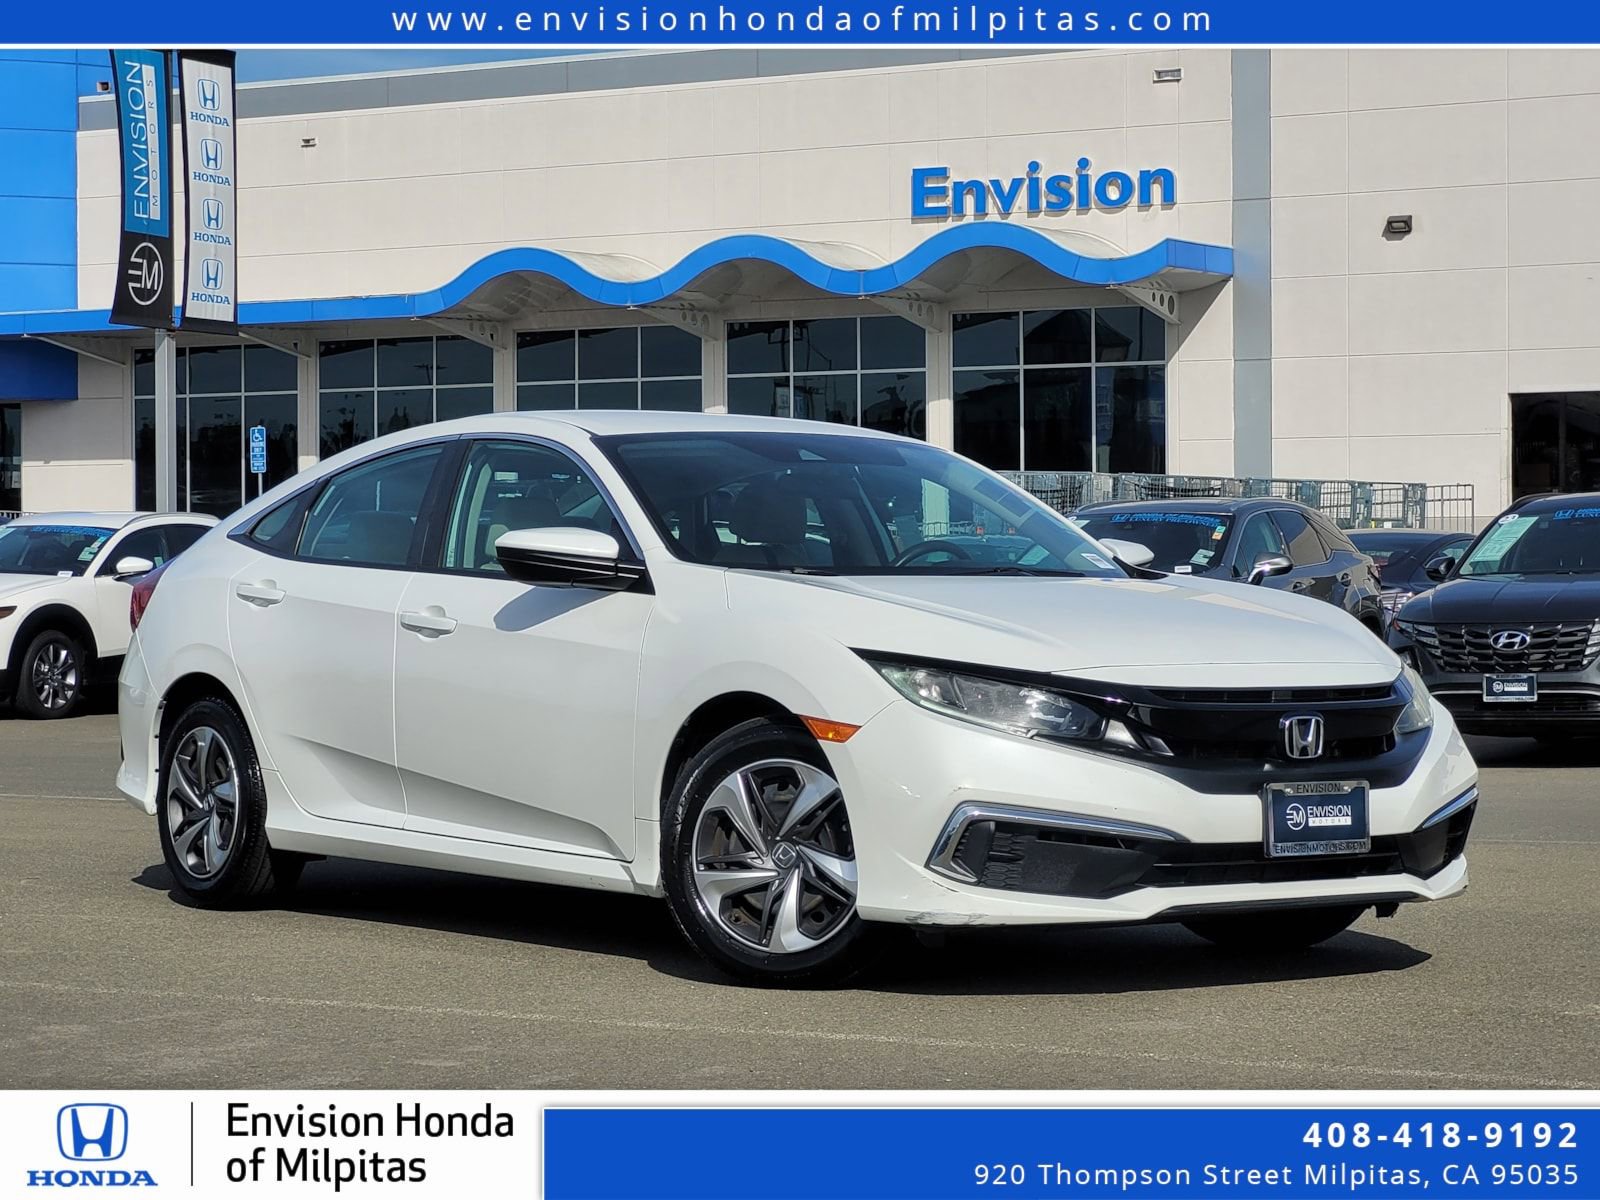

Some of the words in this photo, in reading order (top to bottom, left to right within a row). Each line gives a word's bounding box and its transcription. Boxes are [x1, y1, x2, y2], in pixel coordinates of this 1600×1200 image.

[190, 111, 230, 127] HONDA
[124, 60, 150, 218] ENVISION
[146, 78, 159, 207] MOTORS
[192, 171, 231, 186] HONDA
[911, 157, 1176, 220] Envision
[193, 231, 232, 246] HONDA
[191, 292, 231, 305] HONDA
[1296, 782, 1341, 794] ENVISION
[1307, 805, 1352, 817] ENVISION
